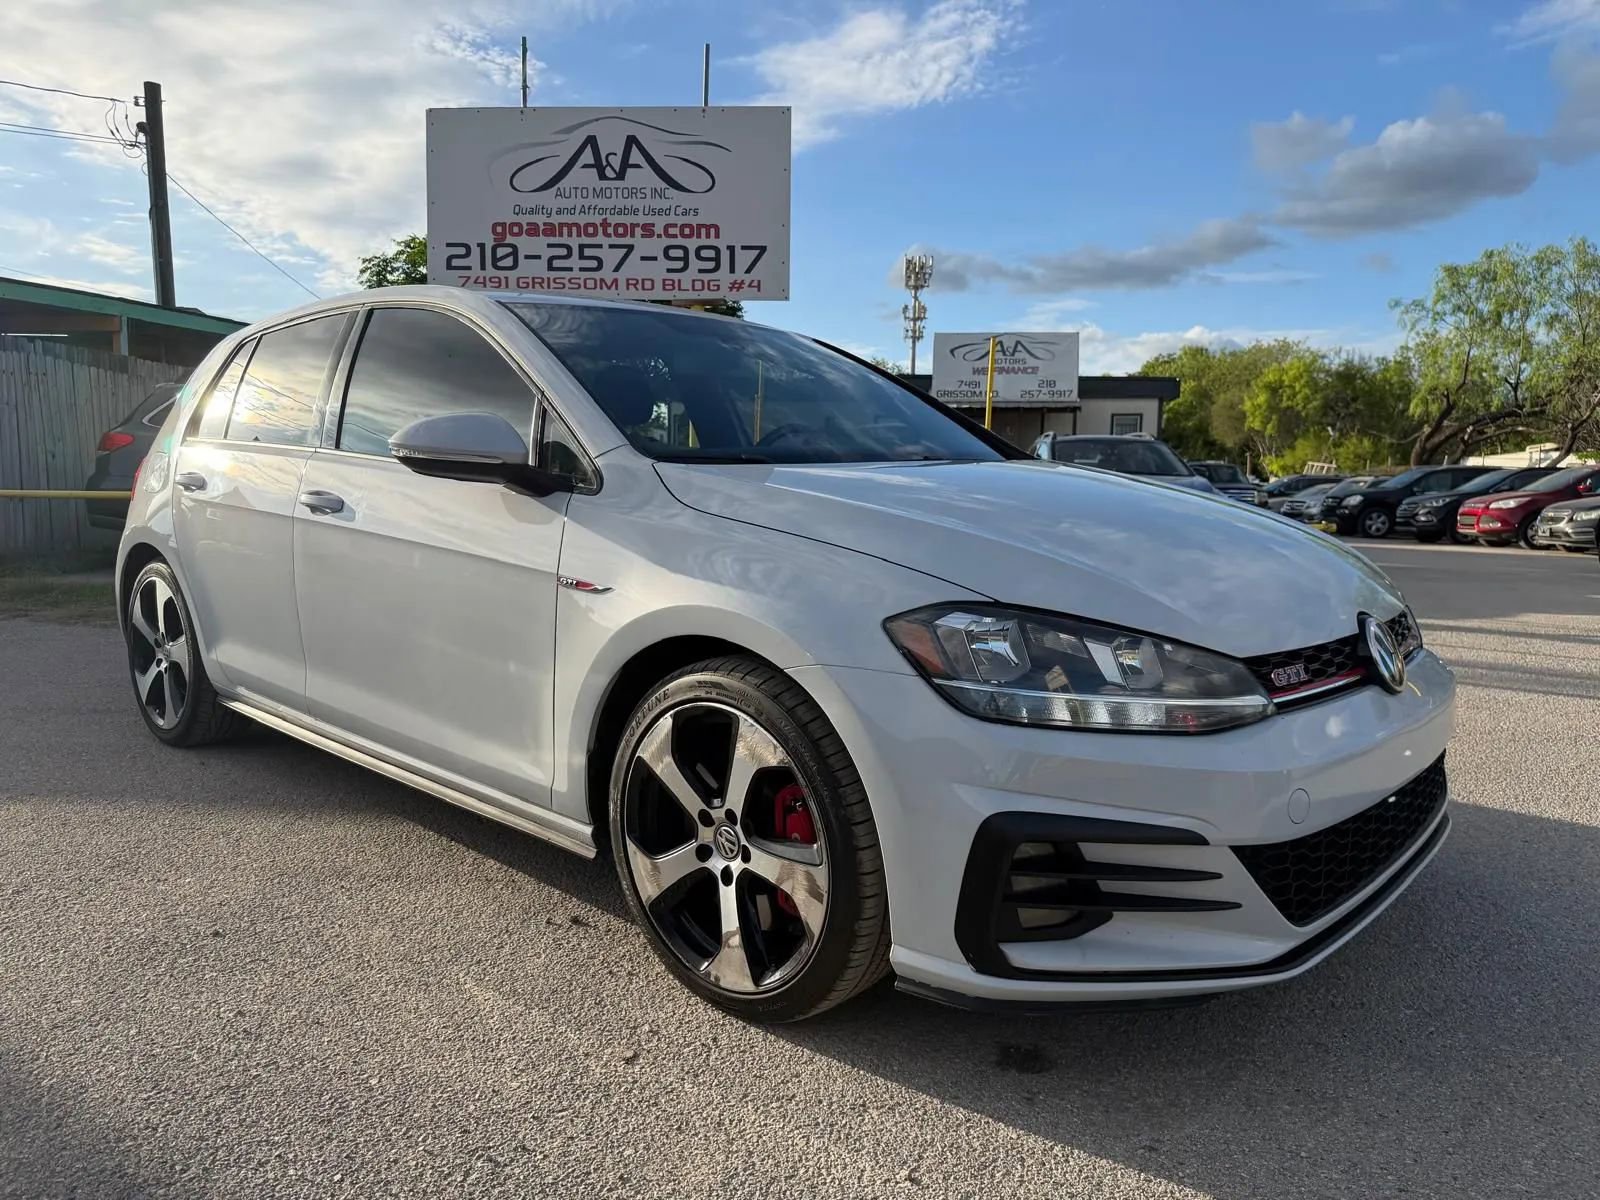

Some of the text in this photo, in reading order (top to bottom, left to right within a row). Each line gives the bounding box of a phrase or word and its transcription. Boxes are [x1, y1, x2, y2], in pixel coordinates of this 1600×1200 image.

[554, 186, 675, 200] AUTO MOTORS INC.
[512, 203, 700, 219] Quality and Affordable Used Cars
[491, 217, 721, 243] goaamotors.com
[445, 242, 767, 274] 210-257-9917
[457, 275, 762, 293] 7491 GRISSOM RD BLDG #4
[957, 380, 981, 389] 7491
[936, 390, 983, 399] GRISSOM
[1020, 390, 1073, 398] 257-9917
[1271, 664, 1308, 687] GTI
